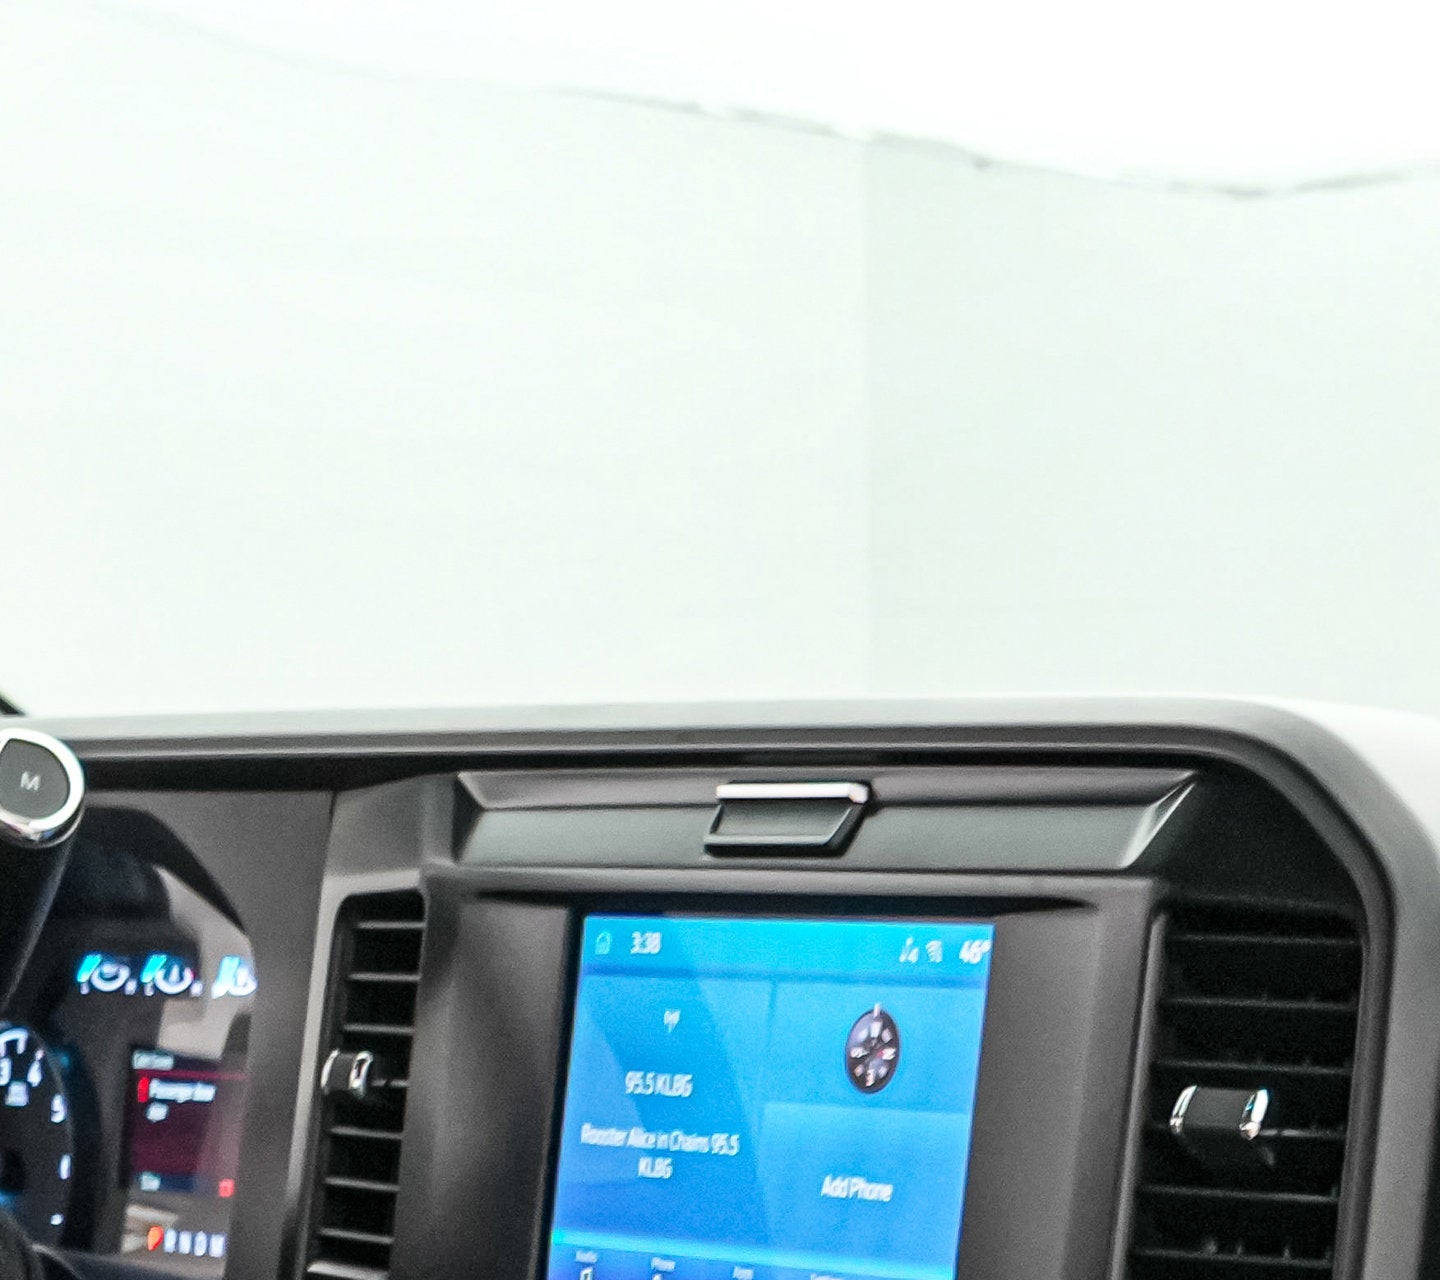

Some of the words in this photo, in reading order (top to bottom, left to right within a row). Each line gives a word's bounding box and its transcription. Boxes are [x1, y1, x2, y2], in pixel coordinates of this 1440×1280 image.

[20, 771, 41, 792] M
[821, 1173, 849, 1198] Add
[849, 1176, 894, 1202] Phone
